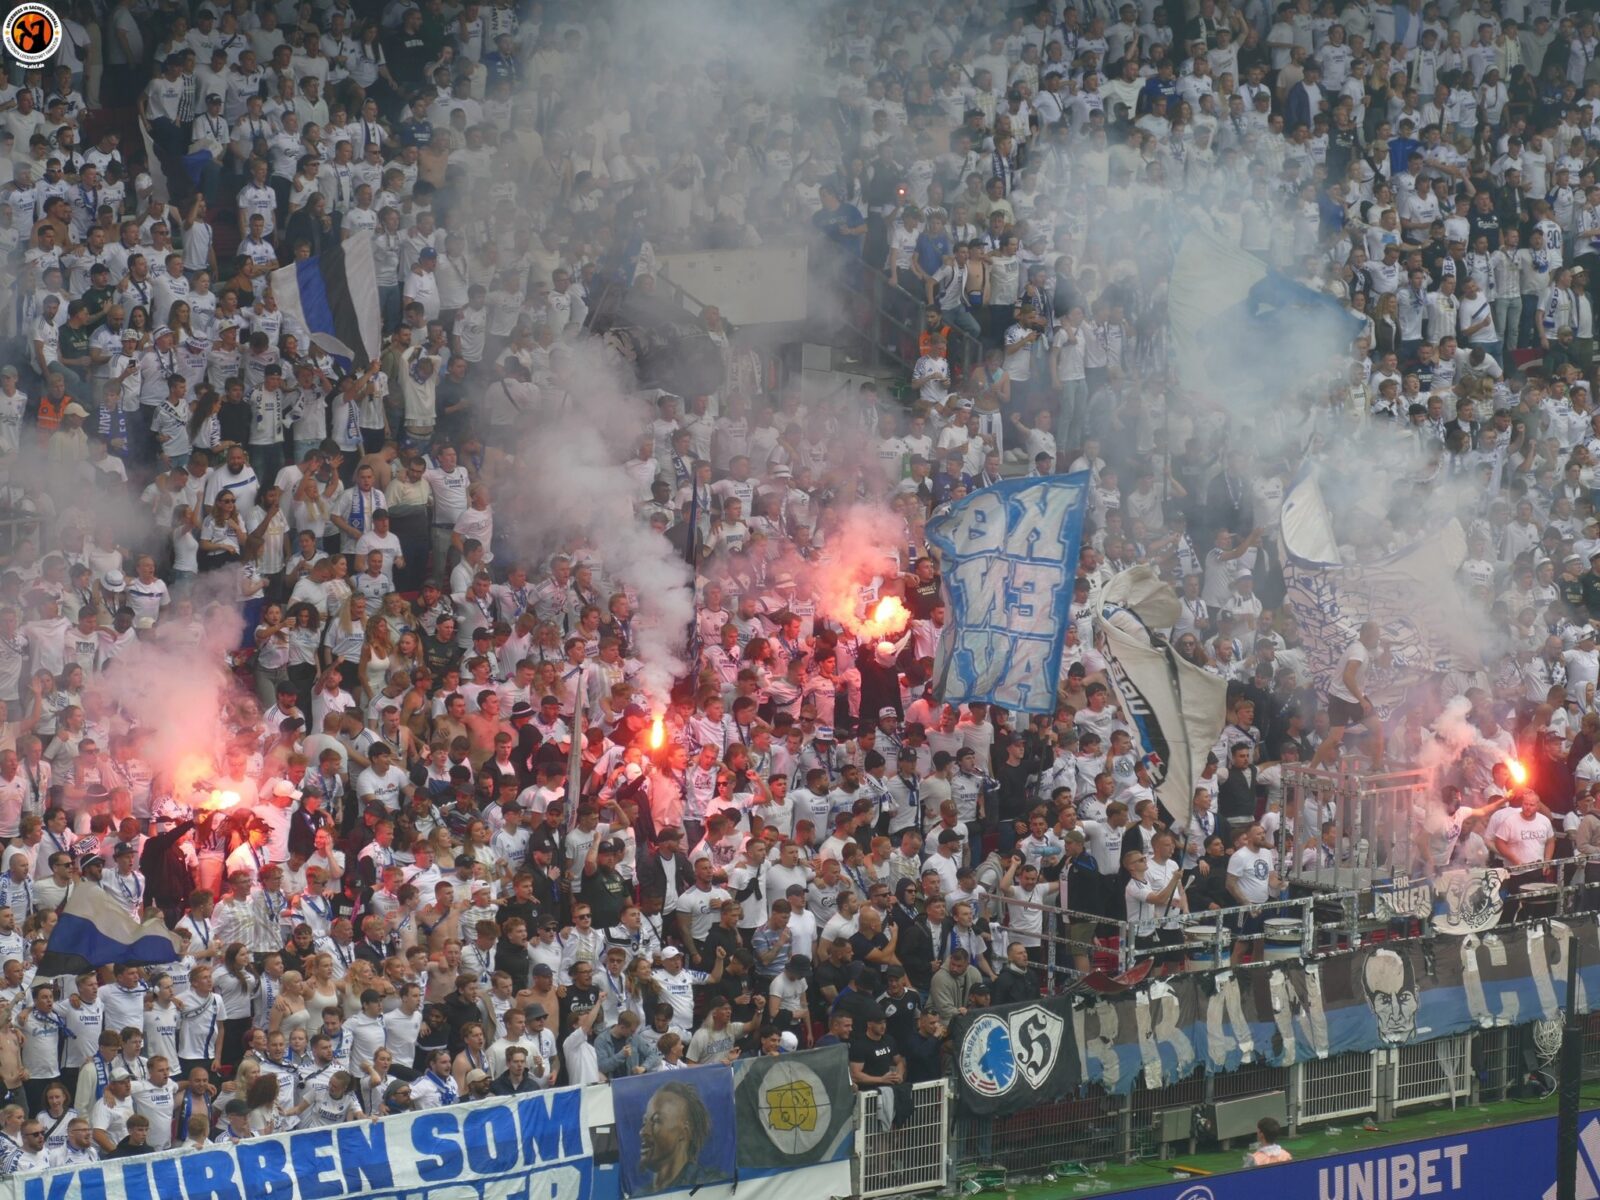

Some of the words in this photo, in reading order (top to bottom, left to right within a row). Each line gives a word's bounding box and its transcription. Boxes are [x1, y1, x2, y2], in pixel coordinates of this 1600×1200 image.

[1547, 230, 1561, 249] 30
[917, 585, 937, 593] UNIBET
[1393, 876, 1409, 889] FOR
[1461, 916, 1600, 1028] CR
[318, 1108, 345, 1121] UNIBET
[48, 1135, 68, 1143] NIBET
[411, 1087, 584, 1183] SOM
[1319, 1143, 1469, 1200] UNIBET
